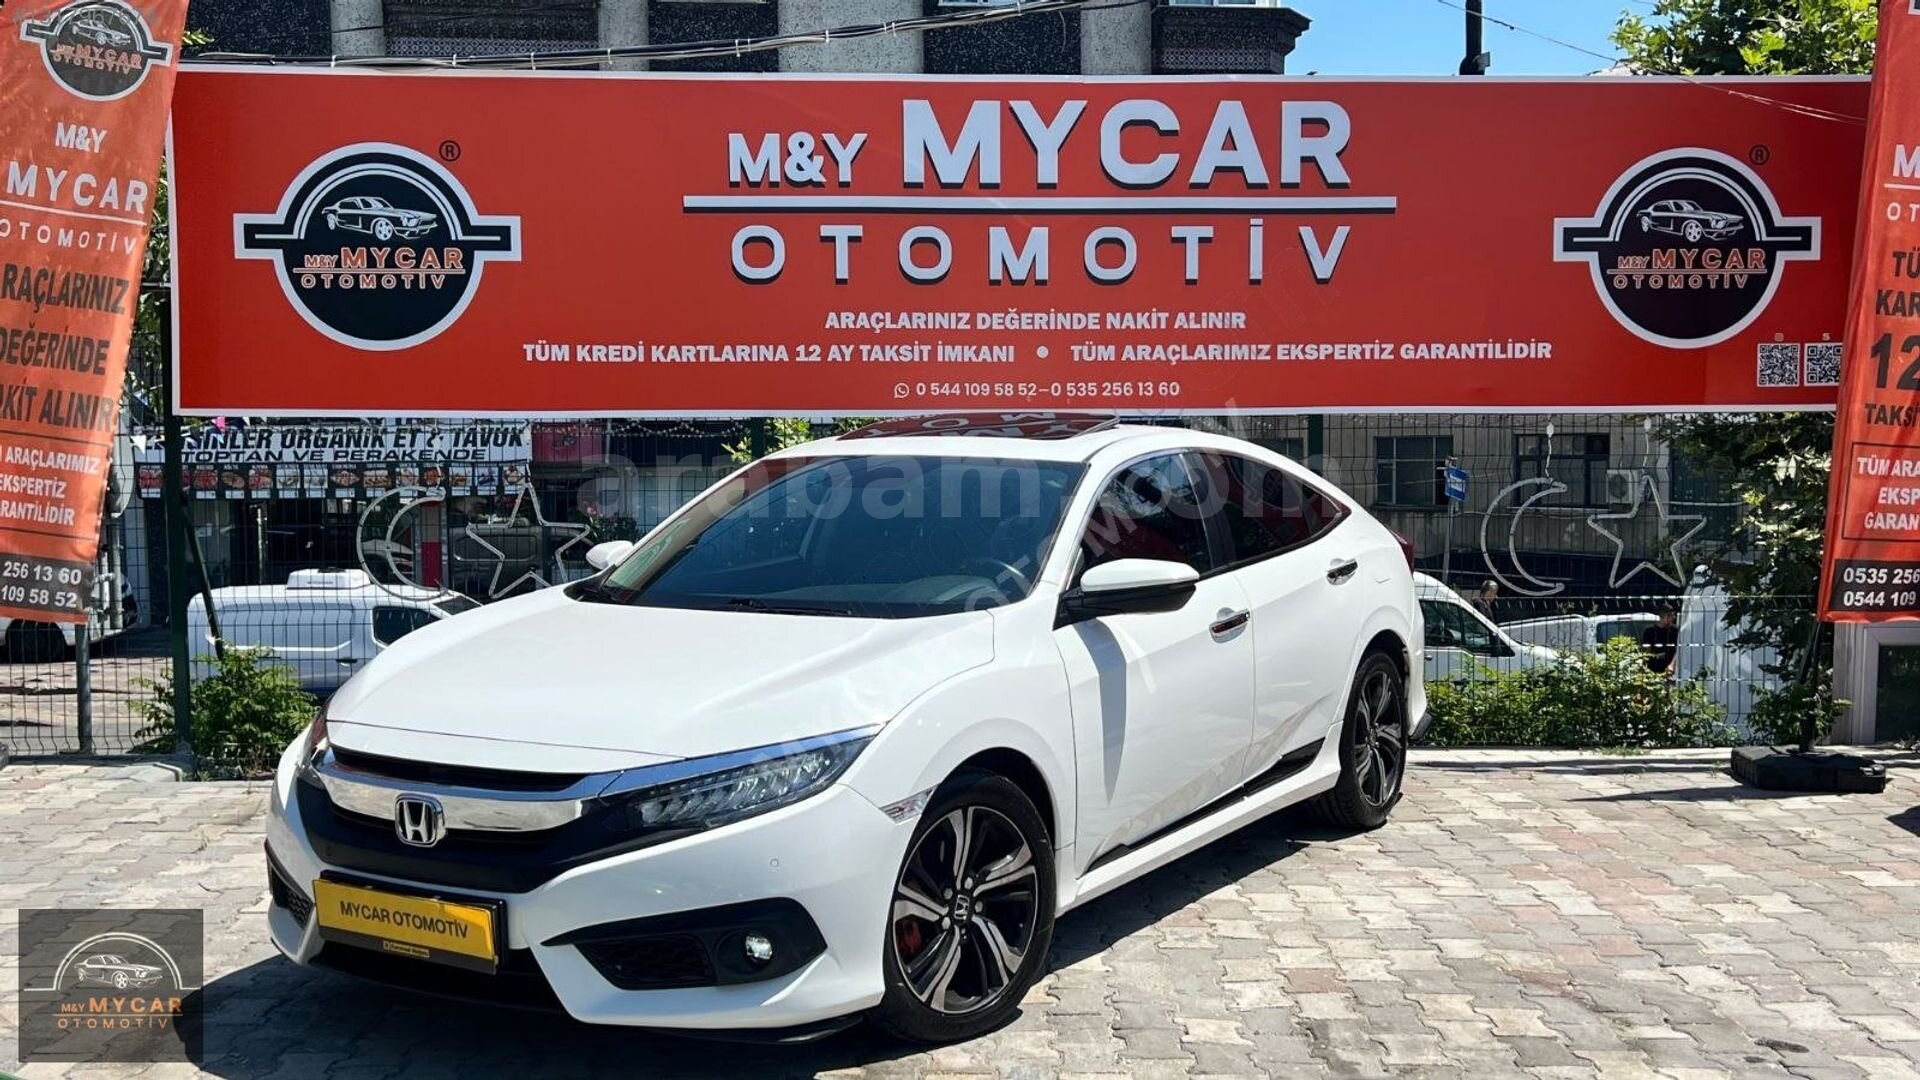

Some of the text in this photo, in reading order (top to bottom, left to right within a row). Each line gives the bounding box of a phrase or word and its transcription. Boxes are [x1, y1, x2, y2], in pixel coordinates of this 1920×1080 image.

[55, 122, 108, 153] M&Y
[729, 99, 1352, 187] M&Y MYCAR
[6, 161, 148, 214] MYCAR
[304, 247, 464, 269] M&Y MYCAR
[731, 218, 1351, 285] OTOMOTİV
[1617, 247, 1767, 269] M&Y MYCAR
[301, 272, 446, 290] OTOMOTİV
[1613, 272, 1748, 290] OTOMOTİV
[825, 307, 1246, 333] ARAÇLARINIZ DEĞERİNDE NAKİT ALINIR
[523, 339, 1015, 363] TÜM KREDİ KARTLARINA 12 AY TAKSİT İMKANI
[1070, 338, 1552, 366] TÜM ARAÇLARIMIZ EKSPERTİZ GARANTİLİDİR
[916, 383, 926, 396] 0
[930, 382, 961, 396] 544
[965, 382, 991, 396] 109
[995, 382, 1014, 396] 58
[1066, 382, 1098, 397] 535
[1102, 382, 1133, 396] 256
[1137, 381, 1154, 396] 13
[1158, 381, 1180, 396] 60
[453, 427, 523, 448] TAVUK
[5, 446, 101, 475] ARAÇLARIMIZ
[181, 449, 487, 462] TOPTAN VE PERAKENDE
[3, 560, 82, 585] 256 13 60
[1843, 567, 1920, 585] 0535 256
[1, 584, 77, 609] 109 58 52
[1843, 591, 1917, 608] 0544 109
[340, 900, 468, 940] MYCAR OTOMOTİV
